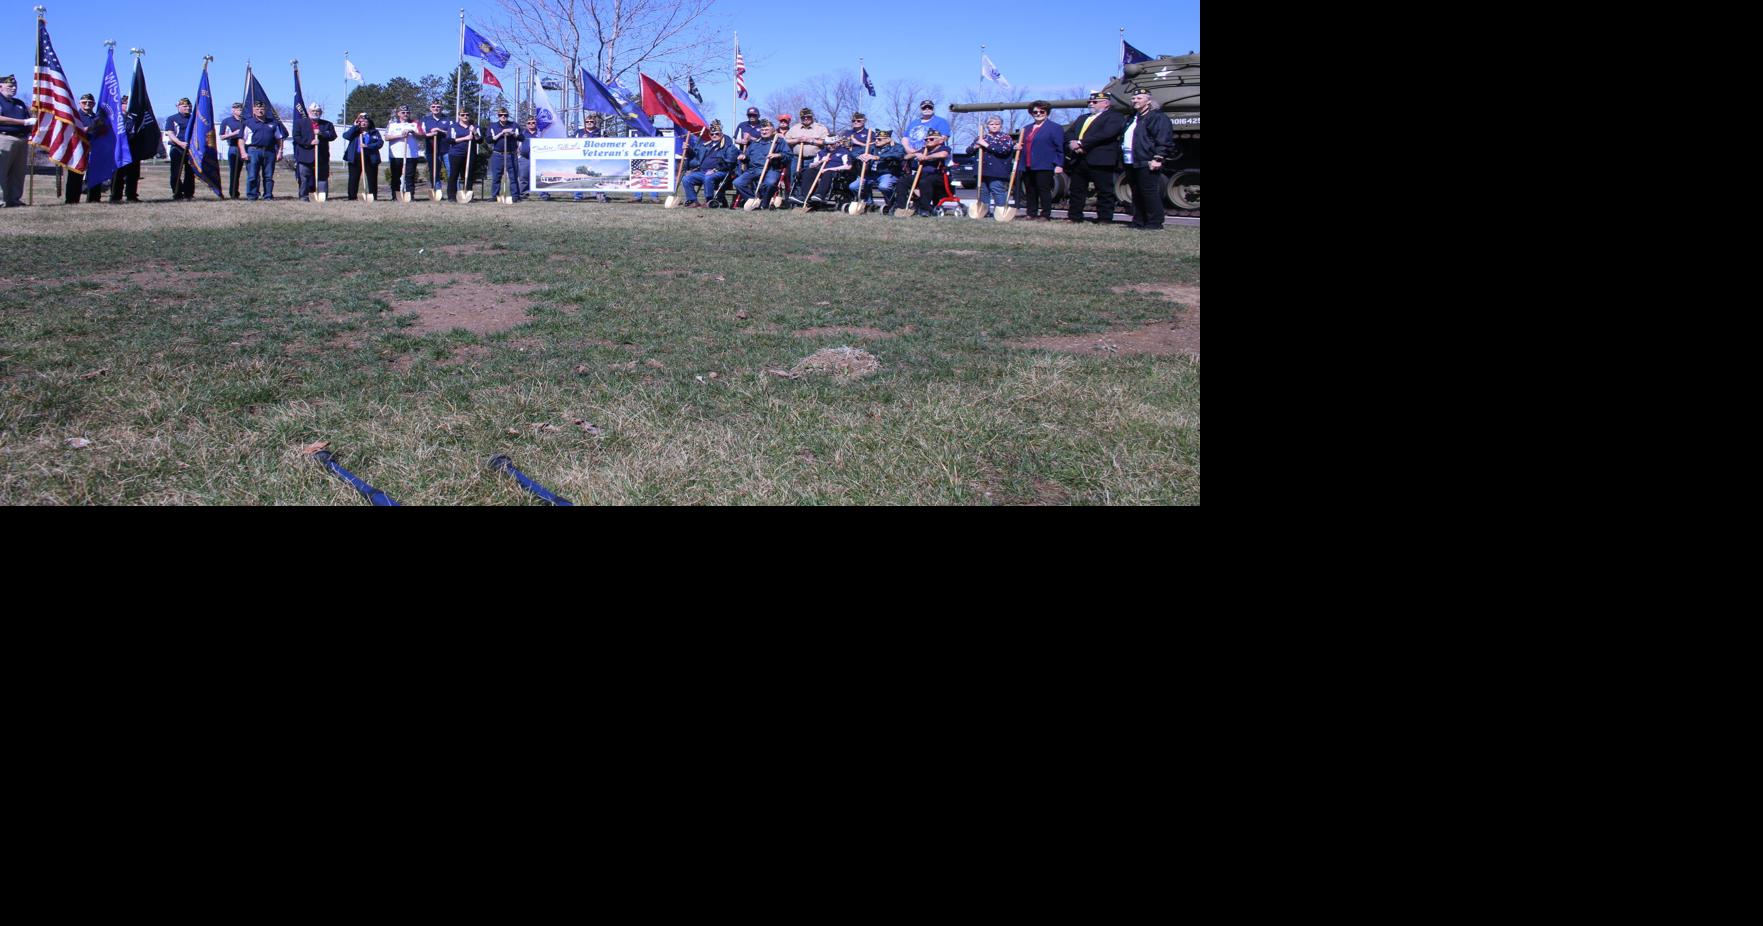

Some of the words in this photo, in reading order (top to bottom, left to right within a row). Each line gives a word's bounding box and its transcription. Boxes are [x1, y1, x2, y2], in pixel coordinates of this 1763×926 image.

[583, 140, 627, 148] Bloomer
[631, 140, 656, 148] Area
[582, 149, 629, 157] Veteran's
[633, 149, 669, 157] Center
